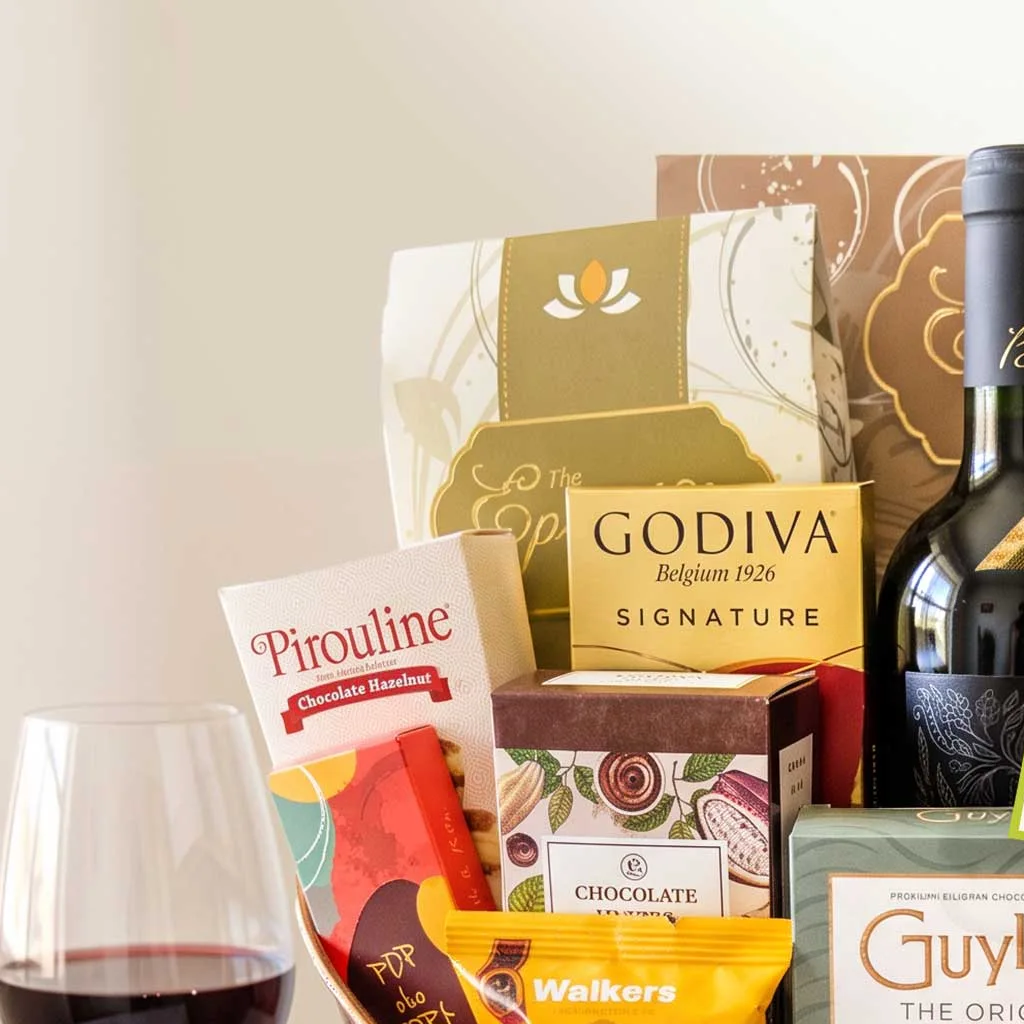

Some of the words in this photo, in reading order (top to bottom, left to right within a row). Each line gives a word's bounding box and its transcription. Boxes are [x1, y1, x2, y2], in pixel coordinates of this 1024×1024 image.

[550, 467, 582, 489] The
[593, 510, 838, 556] GODIVA
[656, 563, 729, 587] Belgium
[735, 563, 776, 582] 1926
[617, 607, 820, 627] SIGNATURE
[250, 606, 452, 677] Pirouline
[297, 686, 366, 711] Chocolate
[368, 672, 432, 693] Hazelnut
[916, 810, 1010, 824] GUY
[575, 885, 698, 904] CHOCOLATE
[533, 978, 677, 1003] Walkers
[900, 1002, 953, 1021] THE
